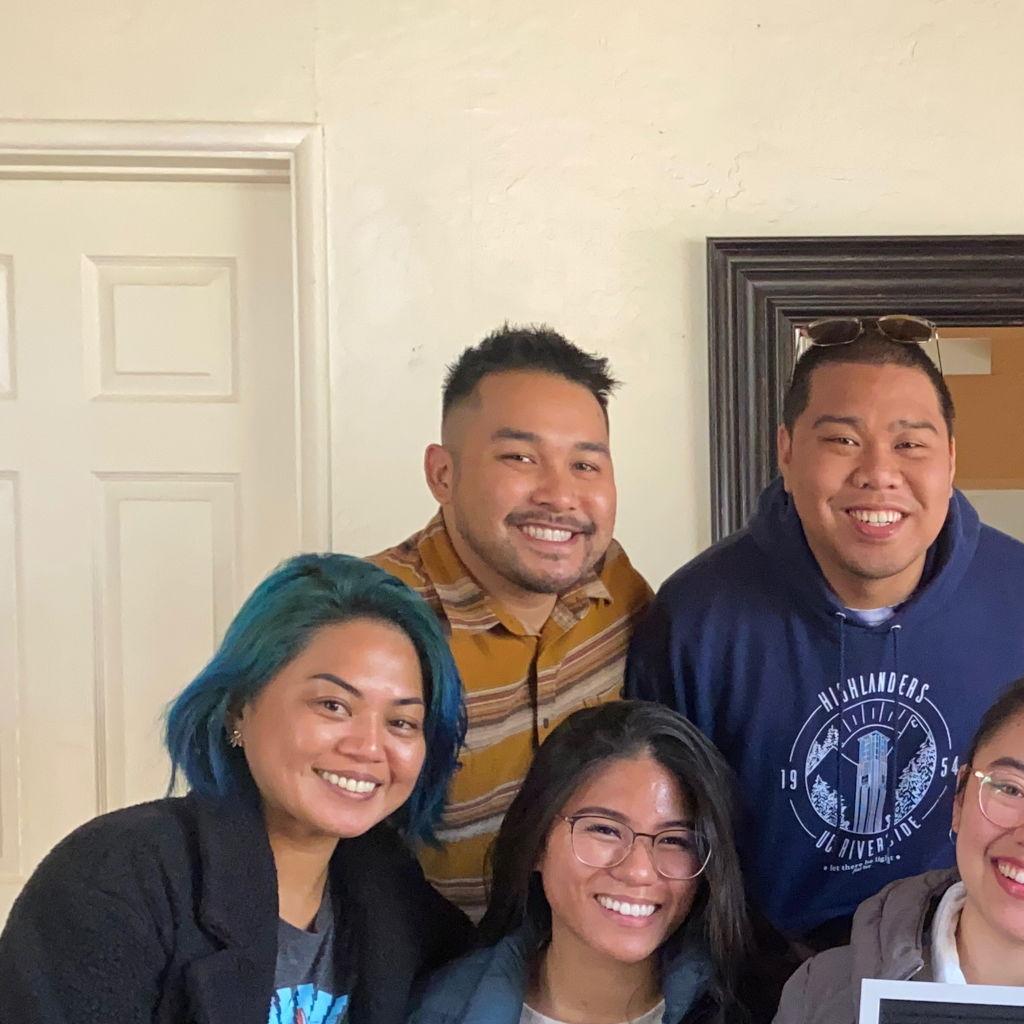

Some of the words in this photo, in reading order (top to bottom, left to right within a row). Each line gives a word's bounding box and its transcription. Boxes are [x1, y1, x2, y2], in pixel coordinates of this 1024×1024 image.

[817, 671, 930, 713] HIGHLANDERS
[781, 769, 798, 790] 19
[940, 755, 959, 777] 54
[815, 830, 836, 853] UC
[838, 815, 922, 860] RIVERSIDE
